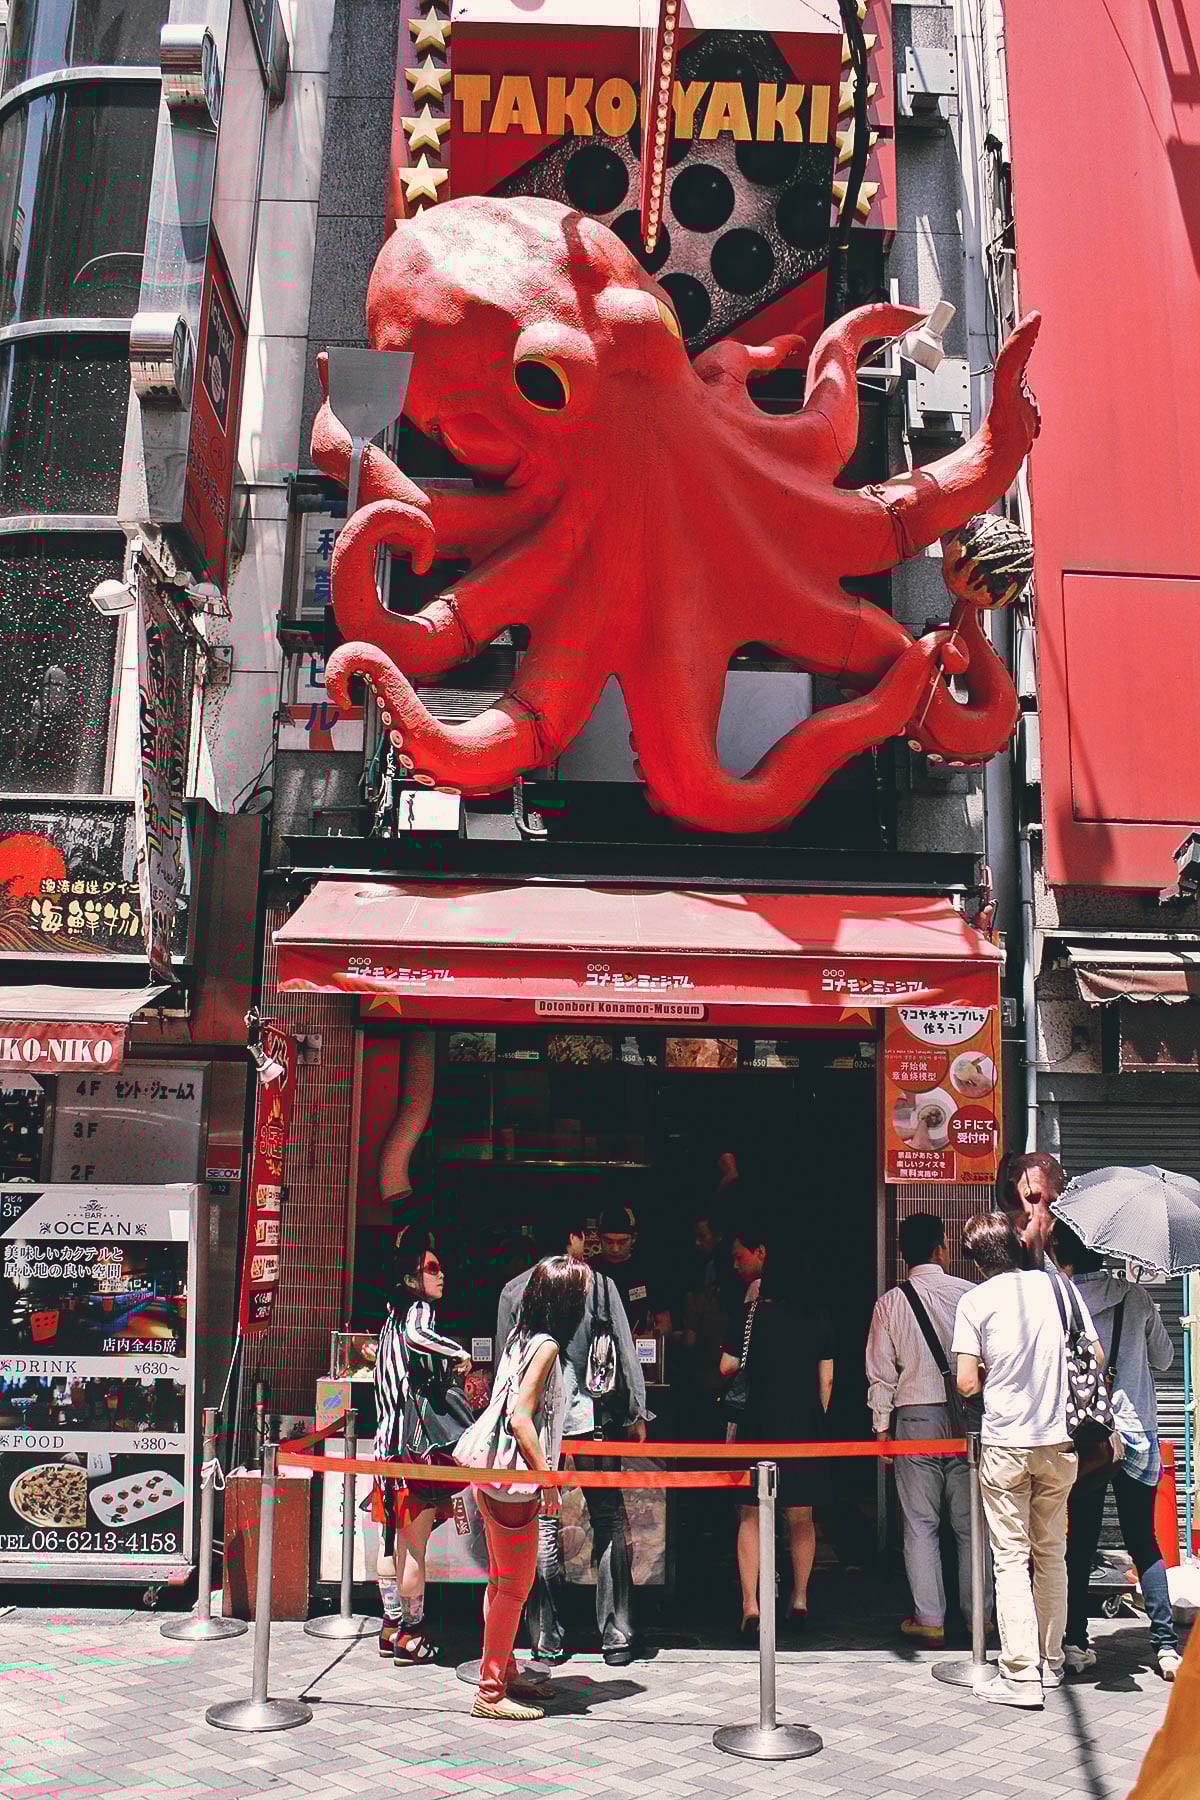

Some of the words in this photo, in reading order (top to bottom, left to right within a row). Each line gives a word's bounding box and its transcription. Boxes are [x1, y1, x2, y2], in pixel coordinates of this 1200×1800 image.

[454, 74, 831, 143] TAKOYAKI
[31, 899, 145, 936] 海鮮物
[586, 973, 695, 988] コナモンミュージアム
[822, 978, 930, 992] コナモンミュージアム
[539, 1001, 595, 1012] Dotonbori
[598, 1002, 700, 1015] Konamon-Museum
[76, 1080, 101, 1096] 4F
[73, 1122, 98, 1138] 3F
[957, 1132, 990, 1143] 受付中
[71, 1165, 95, 1180] 2F
[207, 1169, 239, 1178] SECOM
[2, 1203, 22, 1217] 3F
[54, 1221, 131, 1236] OCEAN
[4, 1244, 124, 1262] 美味しいカクテルと
[4, 1262, 122, 1279] 居心地の良い空間
[102, 1337, 178, 1353] 店内全45席
[16, 1360, 77, 1373] DRINK
[13, 1435, 64, 1448] FOOD
[32, 1530, 177, 1552] 06-6213-4158
